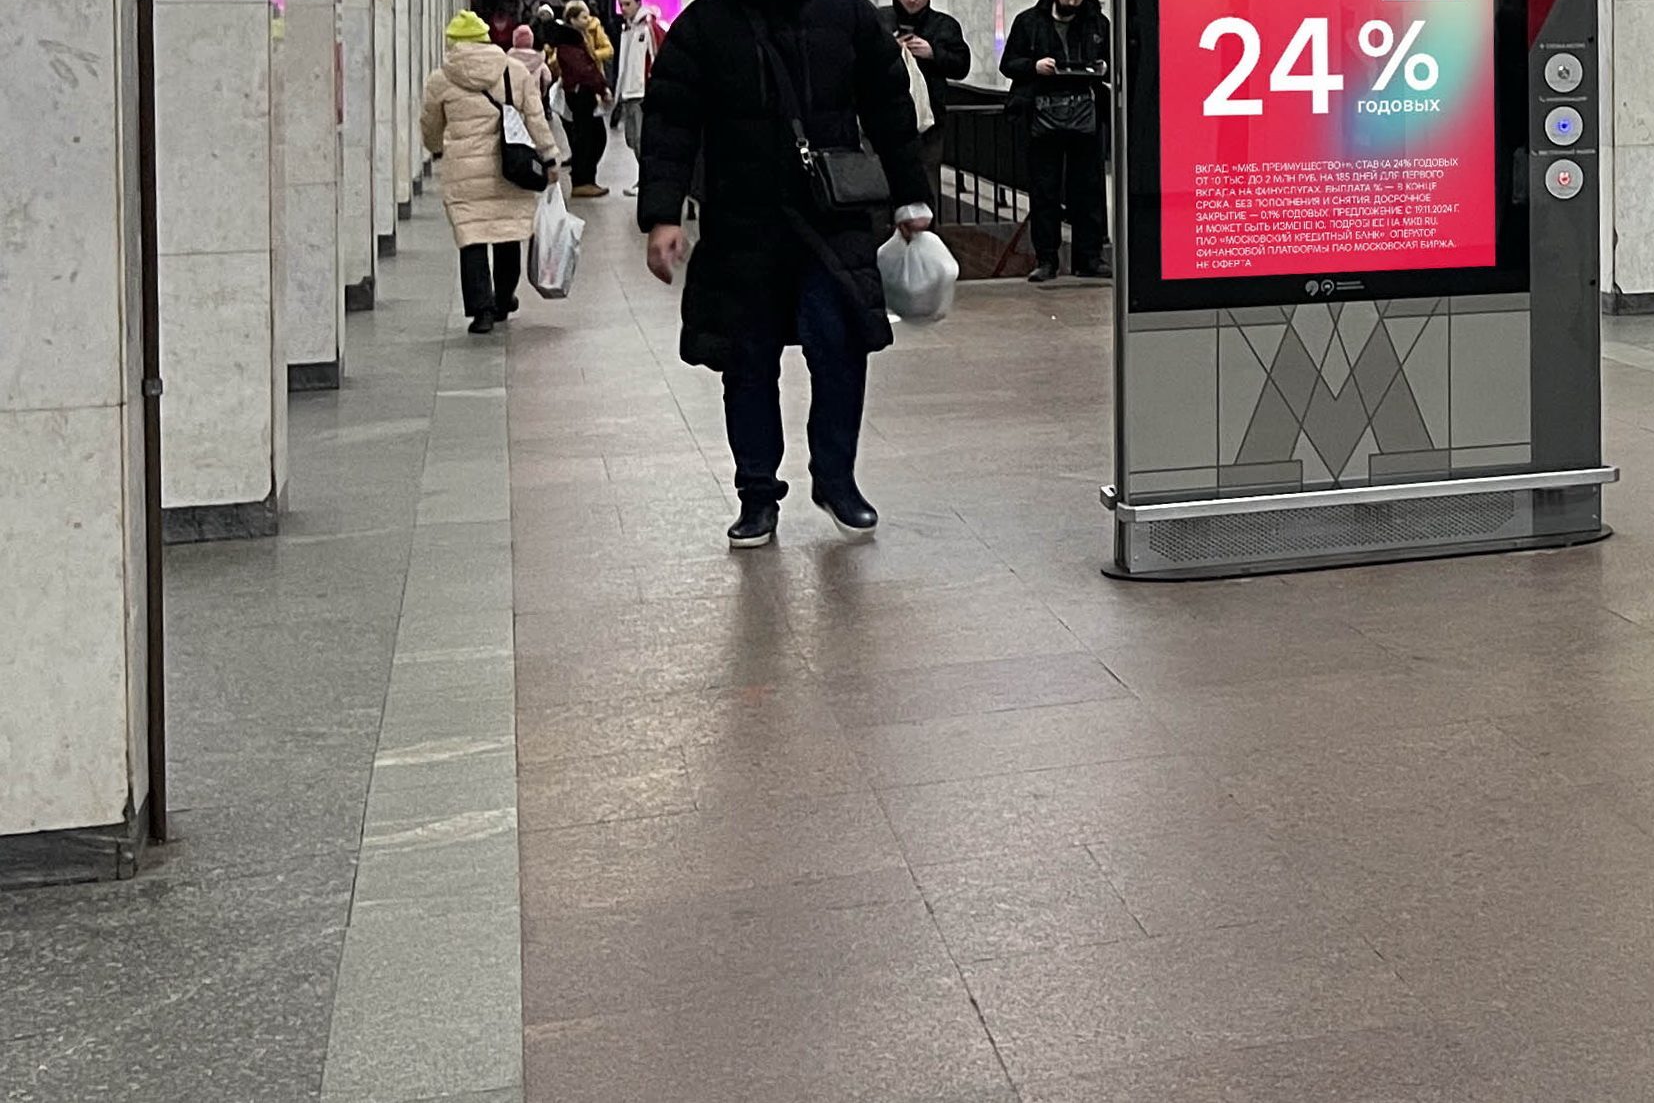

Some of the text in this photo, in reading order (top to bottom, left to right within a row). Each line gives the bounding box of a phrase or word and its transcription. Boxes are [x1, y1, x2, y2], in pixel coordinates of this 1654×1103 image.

[1198, 16, 1440, 116] 24 %
[1357, 98, 1441, 115] годовых
[1356, 160, 1391, 169] СТАВКА
[1394, 159, 1411, 168] 24%
[1414, 158, 1458, 168] ГОДОВЫХ
[1195, 177, 1208, 185] ОТ
[1248, 175, 1262, 185] ДО
[1265, 175, 1271, 183] 2
[1336, 172, 1350, 181] 185
[1353, 170, 1377, 182] ДНЕЙ
[1403, 170, 1443, 179] ПЕРВОГО
[1325, 184, 1370, 193] ВЫПЛАТА
[1235, 199, 1253, 208] БЕЗ
[1323, 196, 1329, 204] И
[1374, 193, 1431, 205] ДОСРОЧНОЕ
[1196, 211, 1247, 221] ЗАКРЫТИЕ
[1333, 206, 1402, 217] ПРЕДЛОЖЕНИЕ
[1405, 206, 1412, 214] С
[1196, 225, 1203, 233] И
[1206, 223, 1242, 233] МОЖЕТ
[1244, 222, 1271, 232] БЫТЬ
[1294, 230, 1352, 242] КРЕДИТНЫЙ
[1390, 228, 1436, 238] ОПЕРАТОР
[1196, 245, 1265, 257] ФИНАНСОВОЙ
[1267, 244, 1329, 255] ПЛАТФОРМЫ
[1332, 243, 1353, 252] ПАО
[1355, 241, 1418, 252] МОСКОВСКАЯ
[1196, 259, 1251, 269] НЕ ОФЕРТА
